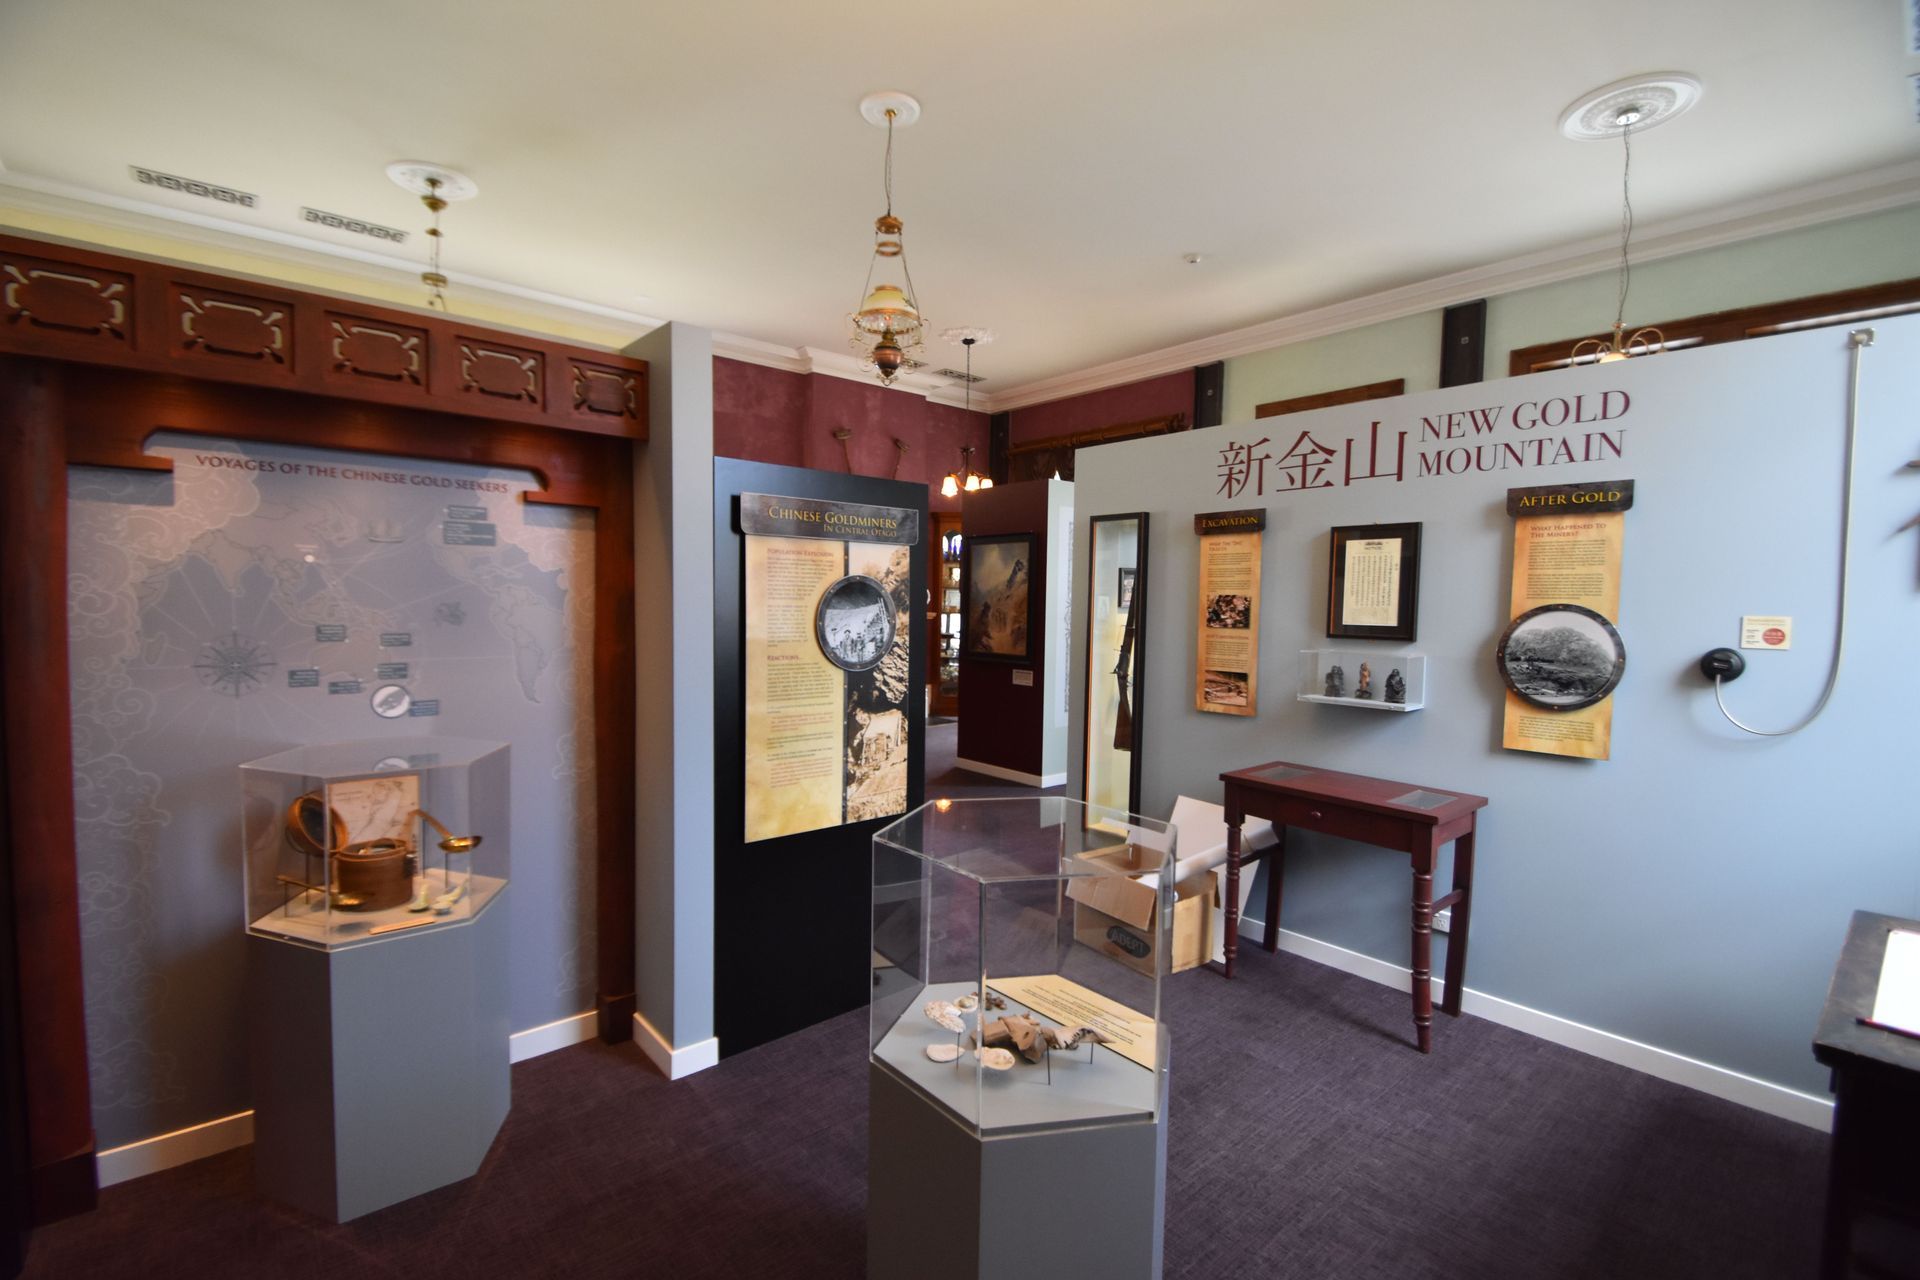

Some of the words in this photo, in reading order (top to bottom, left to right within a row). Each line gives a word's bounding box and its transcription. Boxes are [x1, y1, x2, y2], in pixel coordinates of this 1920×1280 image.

[1419, 406, 1504, 442] NEW
[1512, 390, 1631, 430] GOLD
[1216, 421, 1408, 499] 新金山
[1416, 429, 1626, 478] MOUNTAIN
[195, 455, 275, 473] VOYAGES
[280, 463, 302, 475] OF
[306, 464, 337, 478] THE
[341, 468, 407, 484] CHINESE
[410, 475, 453, 488] GOLD
[455, 479, 508, 494] SEEKERS
[1519, 495, 1567, 508] AFTER
[1571, 490, 1622, 505] GOLD
[768, 505, 821, 523] CHINESE
[824, 511, 897, 530] GOLDMINERS
[823, 524, 833, 533] IN
[835, 525, 869, 537] CENTRAL
[871, 528, 897, 538] OTAGO
[1202, 516, 1259, 528] EXCAVATION
